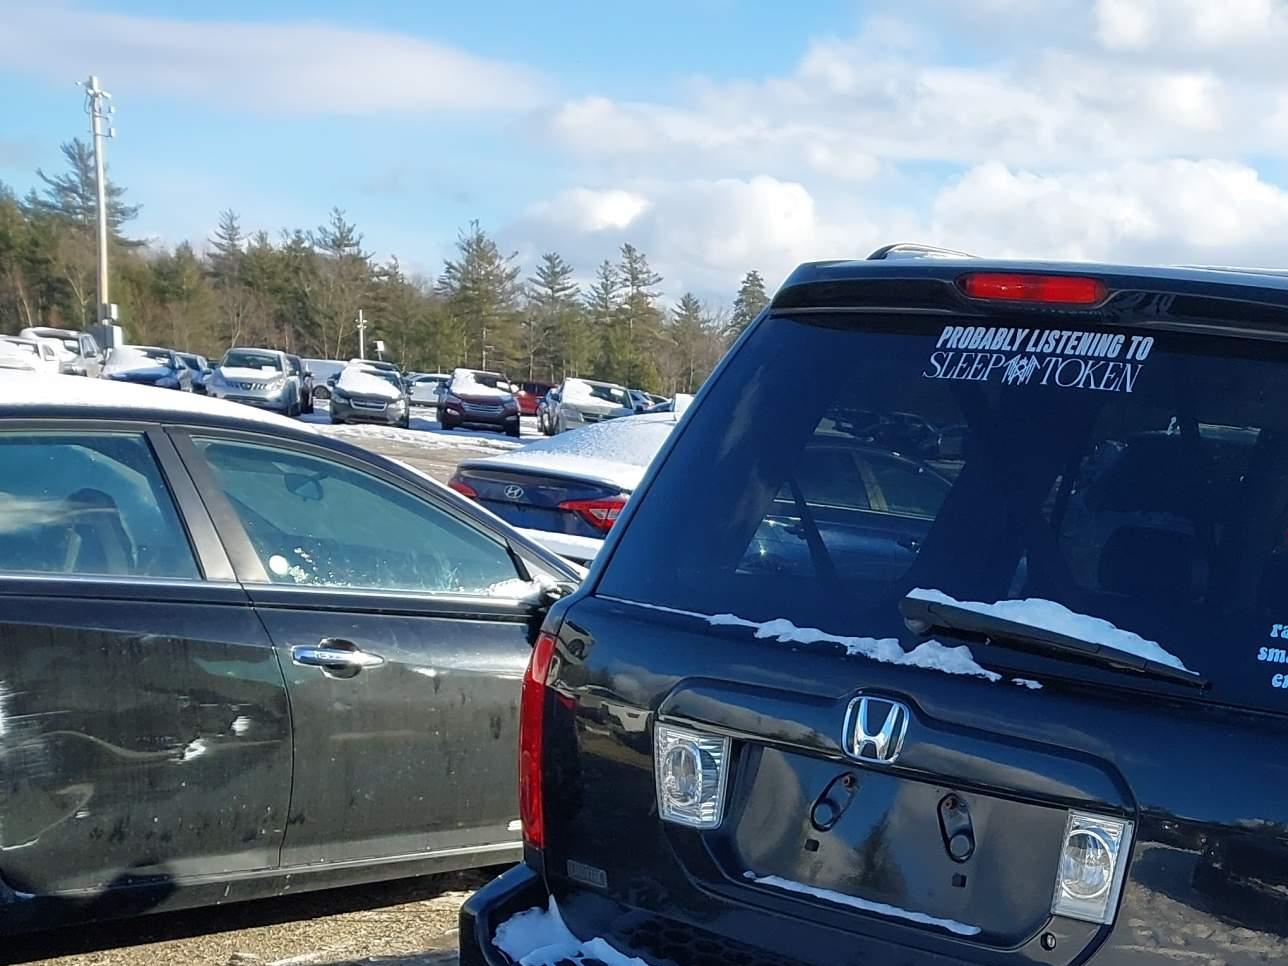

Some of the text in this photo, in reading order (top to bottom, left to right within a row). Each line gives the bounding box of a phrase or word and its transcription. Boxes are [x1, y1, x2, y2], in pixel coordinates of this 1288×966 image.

[935, 326, 1154, 361] PROBABLY LISTENING TO
[922, 351, 1145, 393] SLEEP TOKEN
